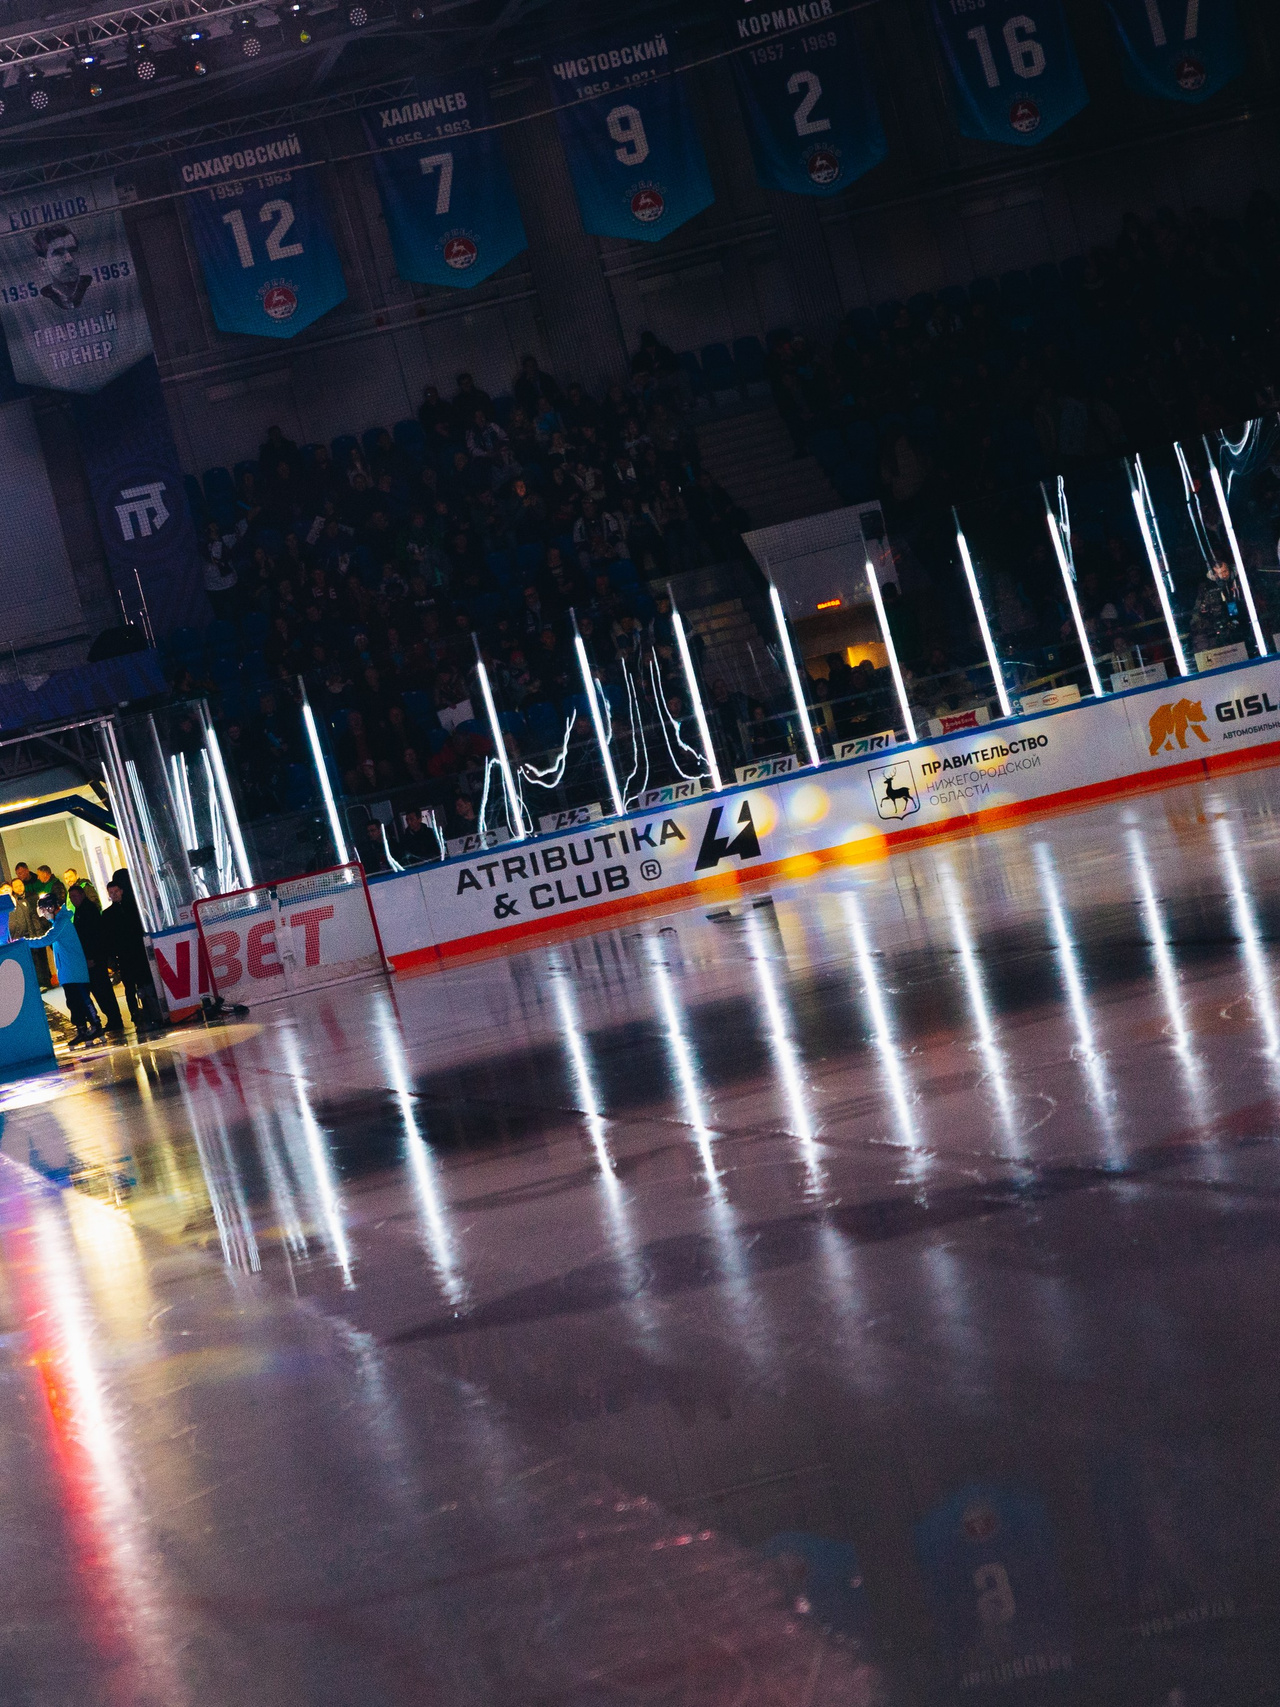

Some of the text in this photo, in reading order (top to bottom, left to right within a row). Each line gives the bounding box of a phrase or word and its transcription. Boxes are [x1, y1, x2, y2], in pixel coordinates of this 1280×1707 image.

[737, 1, 833, 39] КОРМАКОВ
[553, 33, 668, 80] ЧИСТОВСКИЙ
[968, 14, 1047, 88] 16
[379, 91, 467, 129] ХАЛАИЧЕВ
[786, 70, 832, 137] 2
[606, 104, 650, 166] 9
[182, 134, 301, 183] САХАРОВСКИЙ
[419, 153, 453, 215] 7
[10, 196, 89, 231] БОГИНОВ
[222, 199, 304, 268] 12
[2, 261, 130, 304] 1955 1963
[35, 309, 118, 348] ГЛАВНЫЙ
[48, 341, 113, 369] ТРЕНЕР
[841, 735, 889, 758] PARI
[921, 734, 1048, 777] ПРАВИТЕЛЬСТВО
[743, 757, 792, 782] PARI
[926, 754, 1041, 793] НИЖЕГОРОДСКОЙ
[646, 783, 695, 806] PARI
[929, 782, 990, 807] ОБЛАСТИ
[456, 817, 686, 895] ATRIBUTIKA
[531, 865, 629, 911] CLUB
